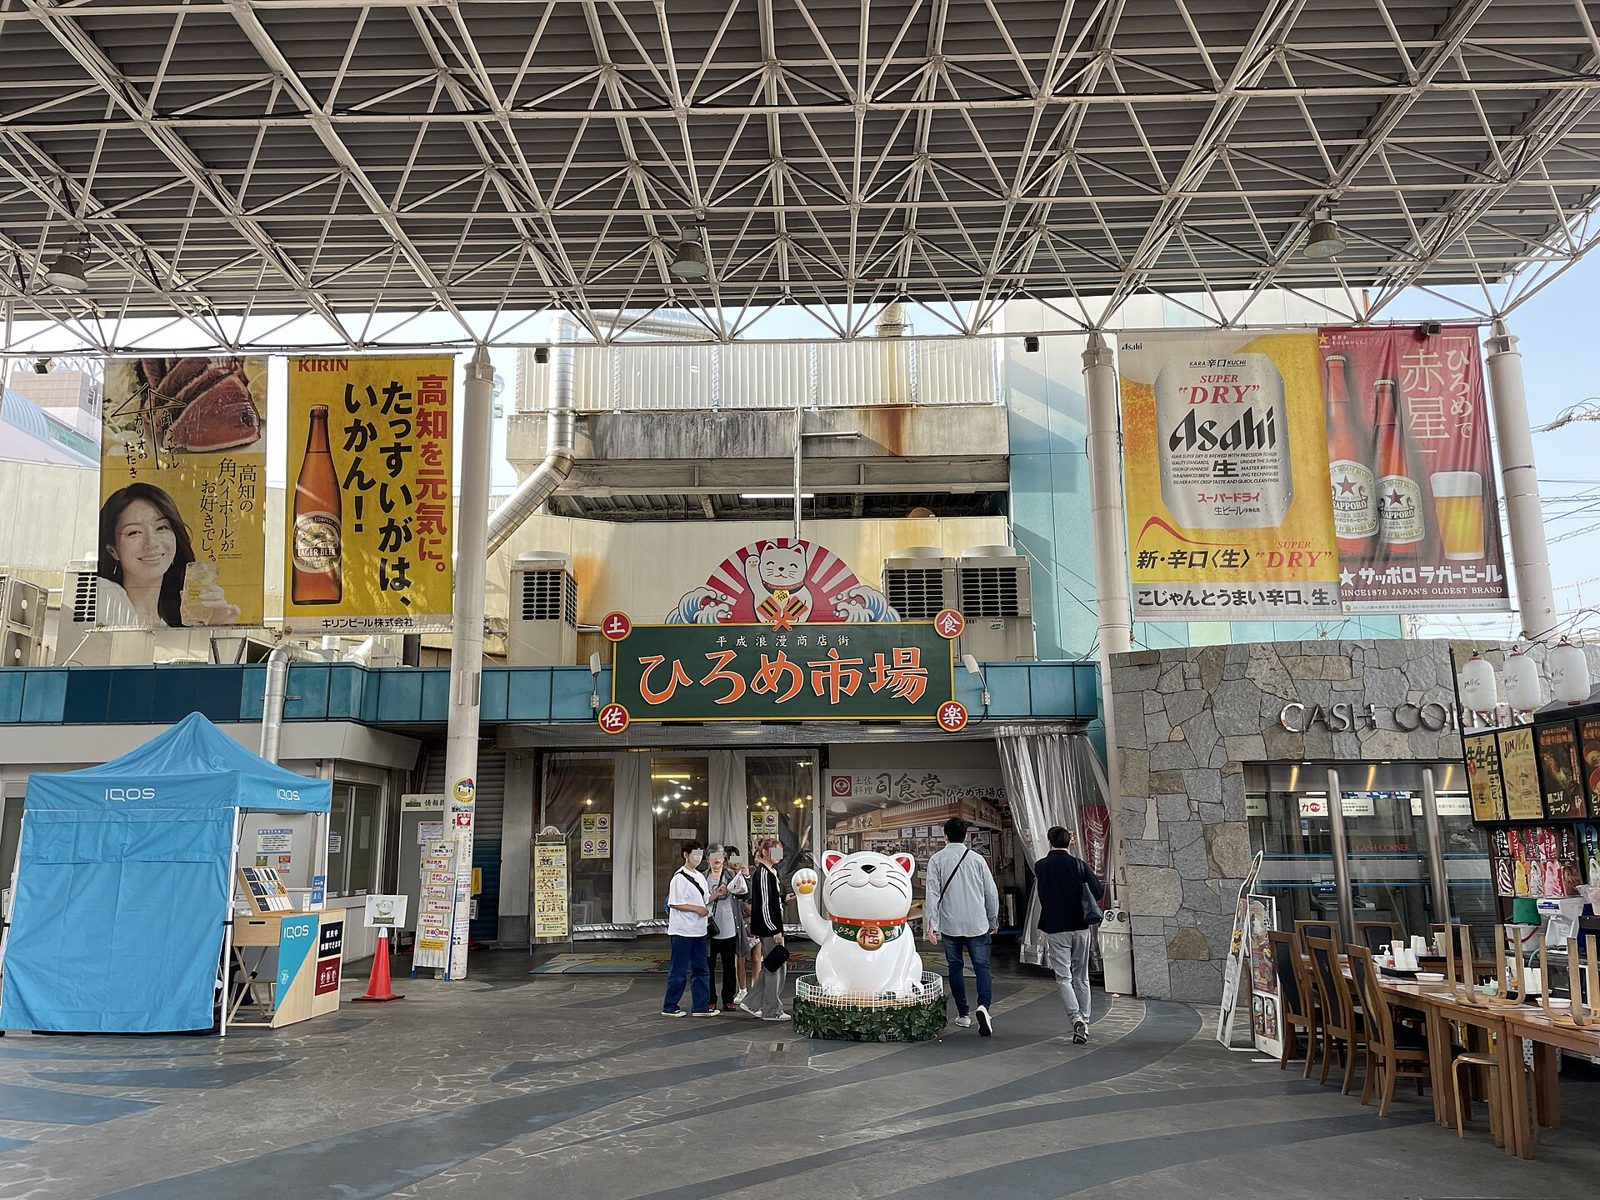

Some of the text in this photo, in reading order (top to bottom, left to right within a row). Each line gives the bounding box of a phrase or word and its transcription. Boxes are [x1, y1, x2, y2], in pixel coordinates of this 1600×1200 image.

[1121, 342, 1143, 351] Asahi
[297, 358, 350, 373] KIRIN
[1200, 374, 1239, 383] SUPER
[1168, 406, 1276, 452] Asahi
[124, 441, 138, 479] たたき
[1212, 459, 1239, 478] 生
[415, 374, 449, 573] 高知を元気に。
[238, 464, 257, 513] 高知の
[218, 458, 237, 553] 角ハイボールが
[1197, 492, 1260, 503] スーパードライ
[1333, 500, 1368, 511] SAPPORO
[200, 480, 218, 562] お好きでしょ。
[1380, 509, 1415, 519] SAPPORO
[297, 547, 336, 557] LAGER BEER
[1277, 541, 1311, 549] SUPER
[1358, 564, 1503, 585] サッポロ ラガービール
[1137, 588, 1338, 607] こじゃんとうまい辛口、生。
[1391, 587, 1428, 596] JAPAN'S
[1431, 586, 1468, 595] OLDEST
[1471, 586, 1503, 595] BRAND
[322, 617, 414, 629] キリンビール株式会社
[606, 615, 628, 634] 土
[938, 613, 961, 633] 食
[716, 634, 851, 647] 平成浪漫商店街
[637, 647, 929, 705] ひろめ市場
[602, 708, 624, 729] 佐
[942, 706, 963, 727] 楽
[1280, 703, 1377, 733] CASH
[854, 776, 874, 786] 土佐
[875, 772, 946, 799] 司食堂
[105, 787, 156, 802] IQOS
[276, 788, 301, 802] IQOS
[854, 786, 874, 796] 料理
[945, 786, 1006, 799] ひろめ市場店
[283, 924, 310, 940] IQOS
[859, 926, 880, 945] 福
